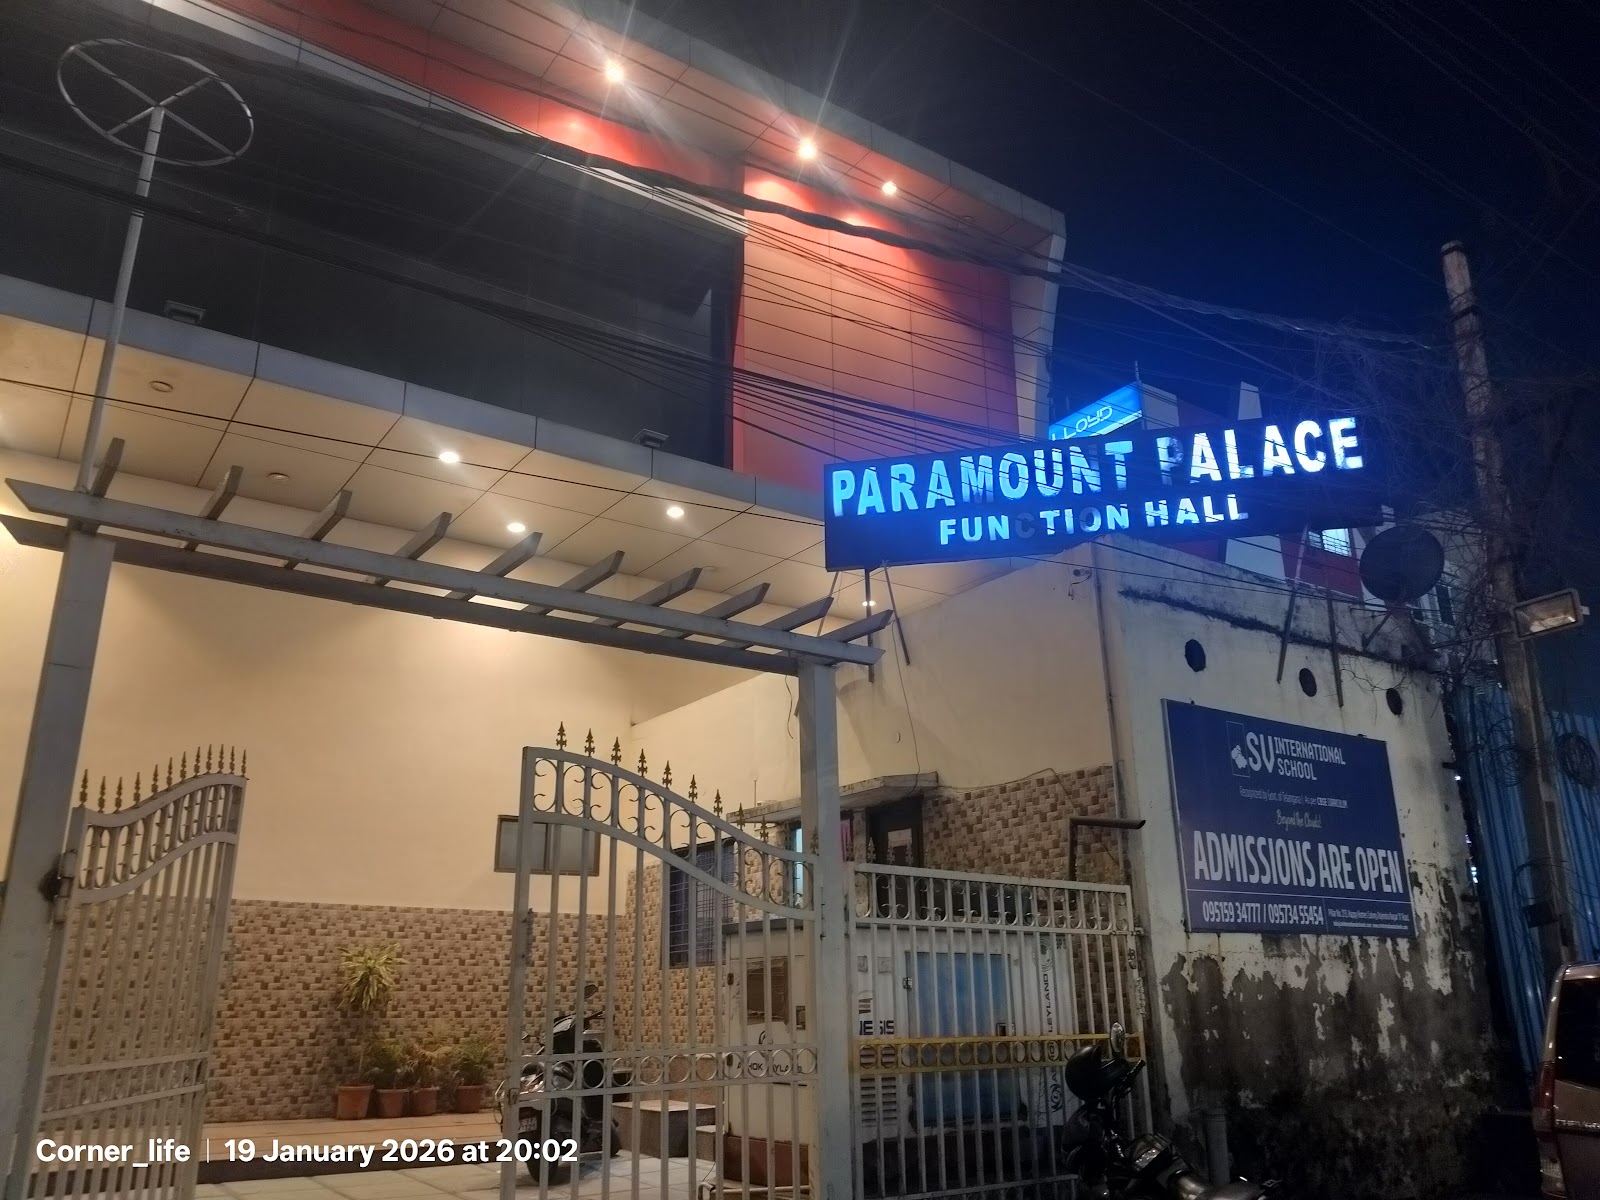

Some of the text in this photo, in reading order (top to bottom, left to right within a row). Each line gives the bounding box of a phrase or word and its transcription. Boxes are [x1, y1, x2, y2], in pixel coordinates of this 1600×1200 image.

[831, 417, 1363, 517] PARAMOUNT PALACE
[940, 494, 1248, 545] FUNCTION HALL
[1246, 732, 1346, 773] SV INTERNATIONAL
[1277, 758, 1317, 780] SCHOOL
[1194, 831, 1403, 893] ADMISSIONS ARE OPEN
[1203, 901, 1235, 922] 095159
[1235, 902, 1260, 923] 34777
[1268, 904, 1299, 924] 095734
[1299, 905, 1324, 925] 55454
[1043, 973, 1053, 1033] LEYLAND
